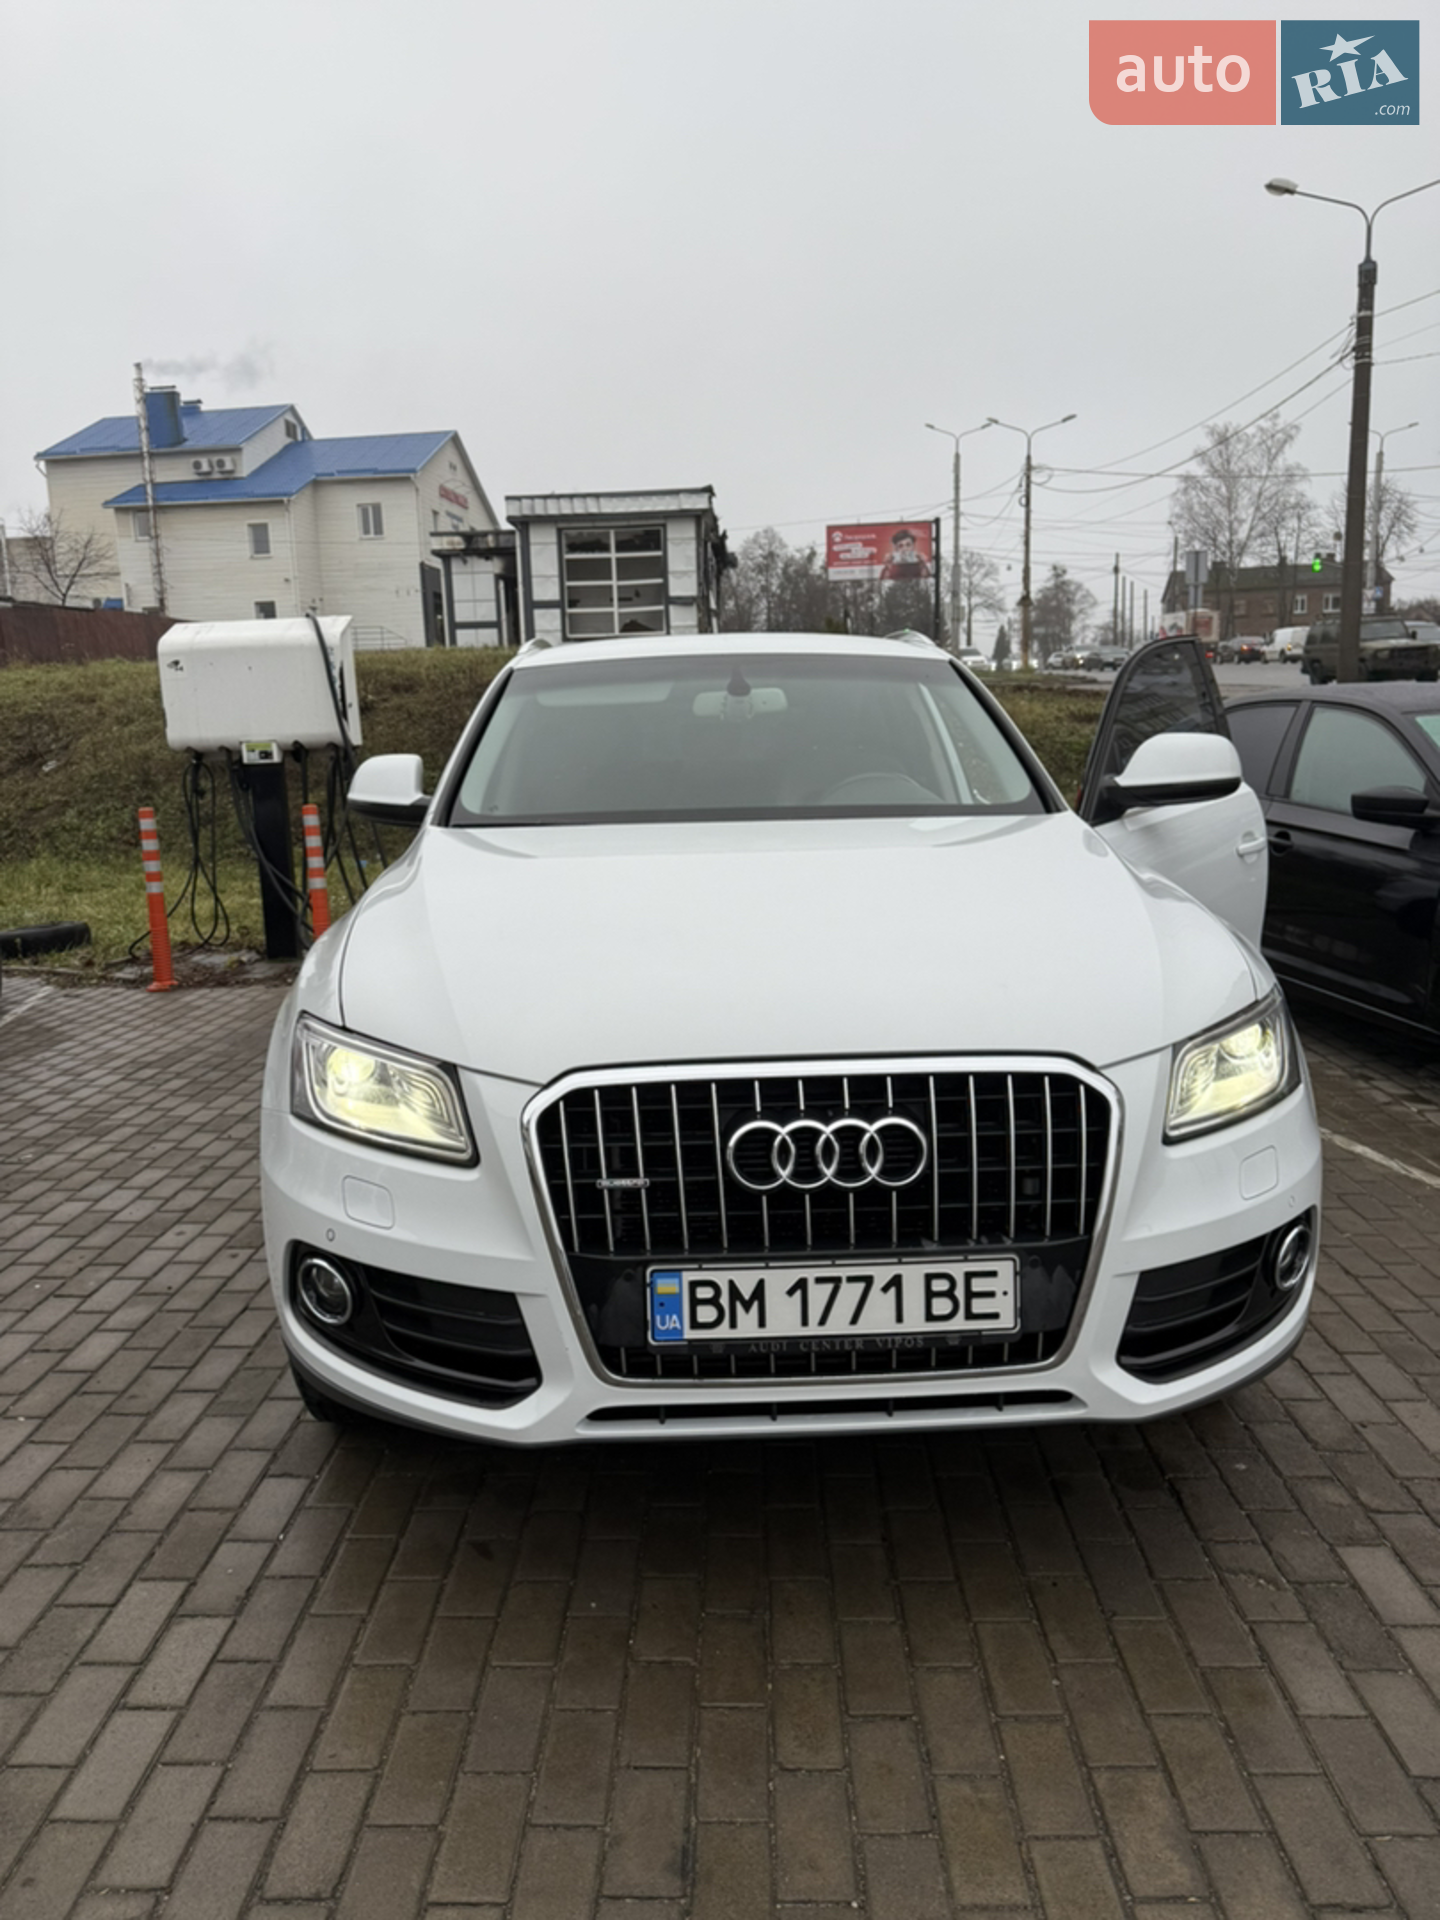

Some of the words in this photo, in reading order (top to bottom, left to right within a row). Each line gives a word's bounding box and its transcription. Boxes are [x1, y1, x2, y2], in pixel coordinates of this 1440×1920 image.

[688, 1278, 767, 1331] BM
[785, 1272, 904, 1327] 1771
[924, 1270, 1001, 1323] BE
[656, 1314, 682, 1331] UA
[748, 1341, 788, 1354] AUDI
[799, 1338, 865, 1352] CENTER
